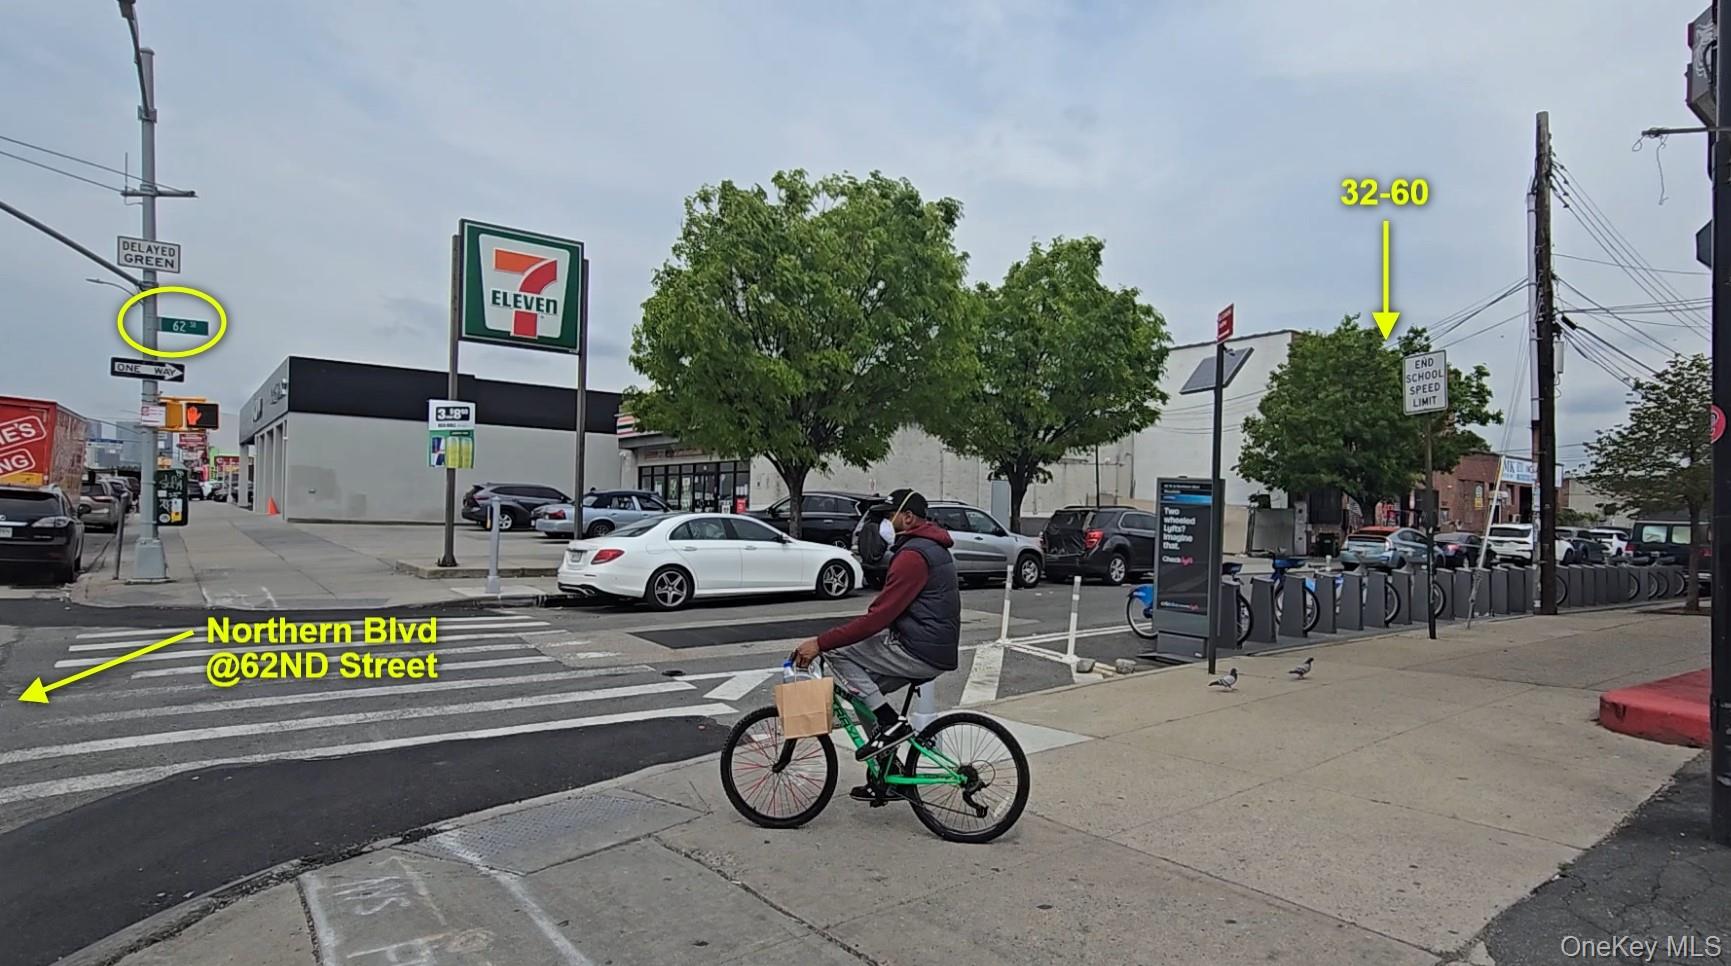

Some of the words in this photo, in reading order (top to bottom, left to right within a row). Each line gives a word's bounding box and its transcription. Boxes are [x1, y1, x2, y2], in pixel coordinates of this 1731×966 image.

[122, 240, 176, 258] DELAYED
[124, 253, 175, 269] GREEN
[172, 320, 187, 333] 62
[1414, 357, 1434, 369] END
[117, 363, 141, 374] ONE
[154, 366, 177, 377] WAY
[1406, 369, 1444, 384] SCHOOL
[1409, 382, 1441, 396] SPEED
[1413, 396, 1438, 408] LIMIT
[0, 422, 37, 445] E'S
[1164, 507, 1180, 516] Two
[1164, 516, 1196, 525] wheeled
[1163, 533, 1194, 543] Imagine
